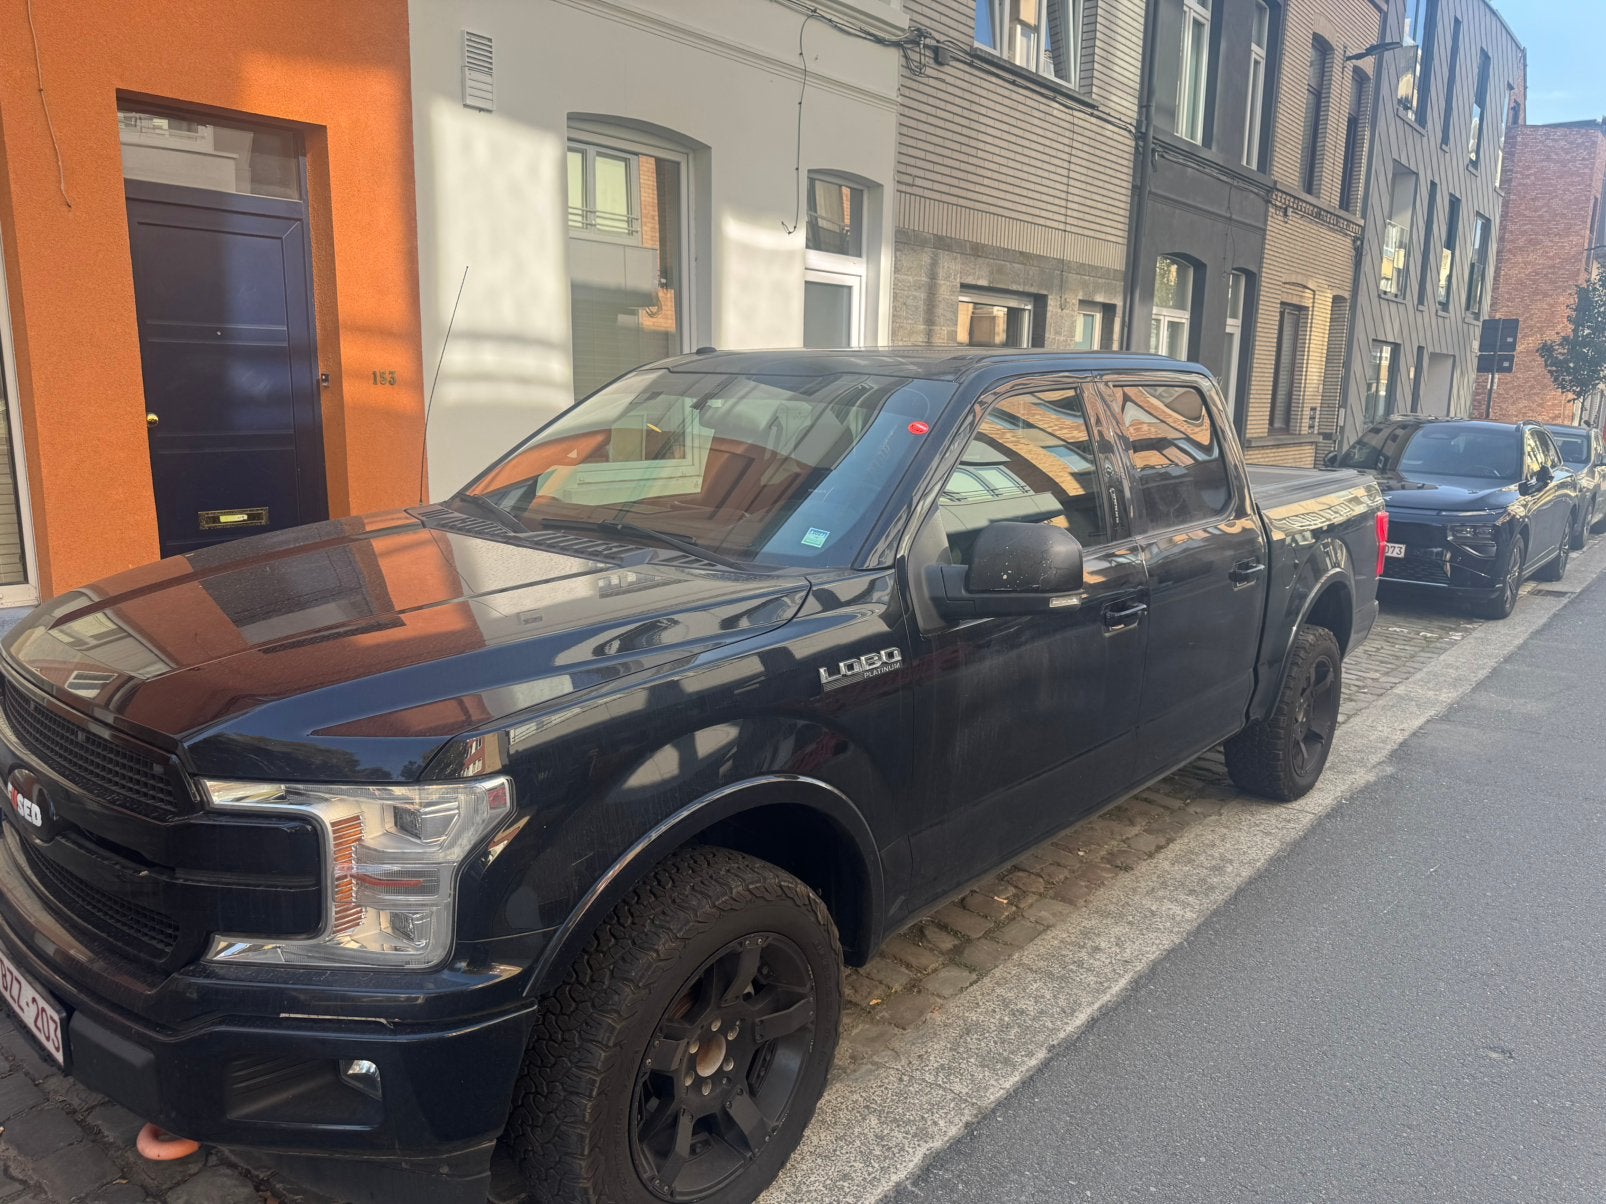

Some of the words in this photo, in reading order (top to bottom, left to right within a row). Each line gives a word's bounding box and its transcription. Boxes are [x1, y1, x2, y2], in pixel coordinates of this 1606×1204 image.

[372, 370, 397, 386] 153
[818, 647, 903, 684] LOBO
[864, 662, 902, 679] PLATINUM
